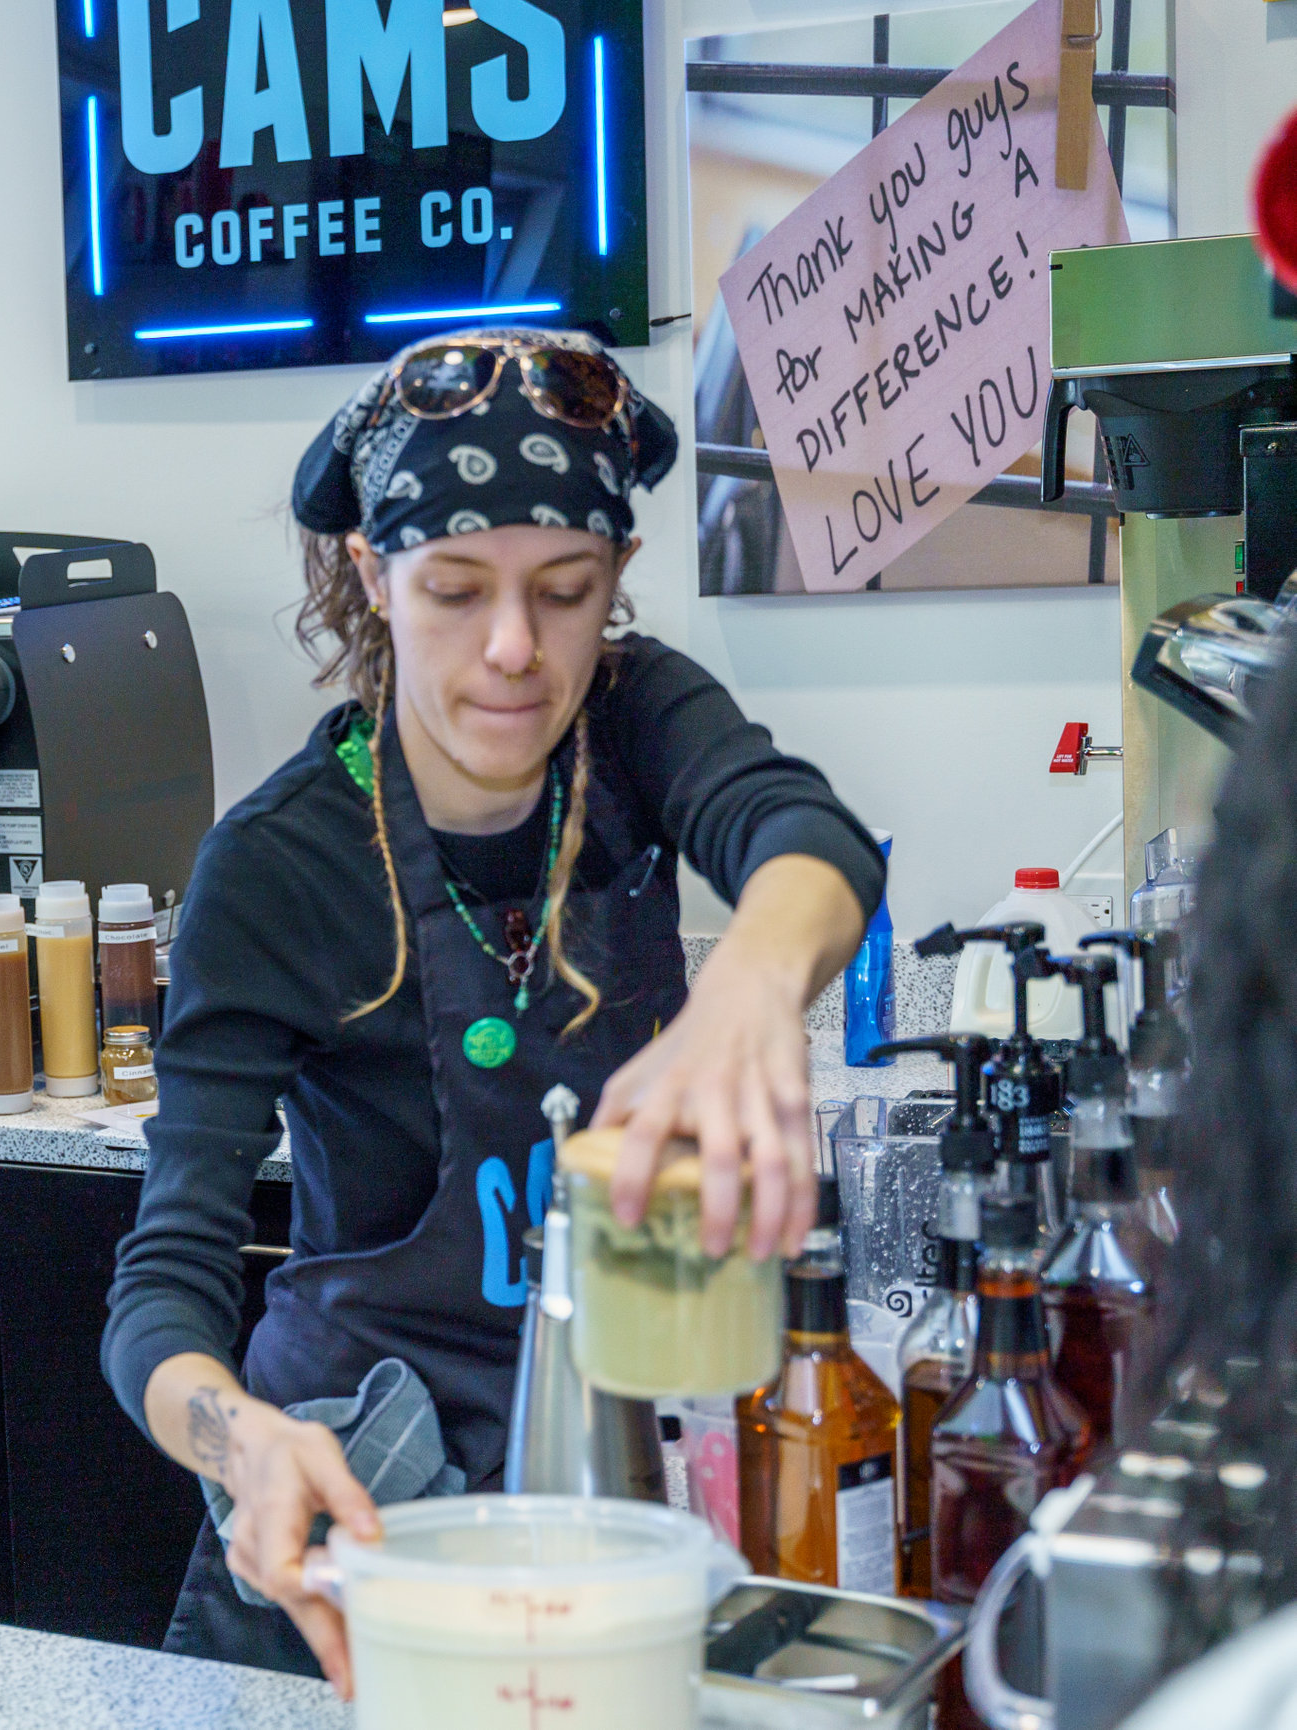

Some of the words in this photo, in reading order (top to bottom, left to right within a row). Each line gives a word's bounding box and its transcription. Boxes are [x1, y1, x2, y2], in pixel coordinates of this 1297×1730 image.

[117, 0, 566, 174] CAMS
[747, 216, 852, 325] Thank
[869, 143, 926, 254] you
[947, 61, 1030, 178] guys
[174, 197, 382, 269] COFFEE
[420, 187, 513, 249] CO.
[776, 344, 823, 404] for
[843, 201, 975, 343] MAKING
[1014, 148, 1039, 197] A
[796, 231, 1036, 472] DIFFERENCE!
[826, 434, 940, 576] LOVE
[951, 346, 1039, 468] YOU
[105, 932, 149, 941] Chocolate
